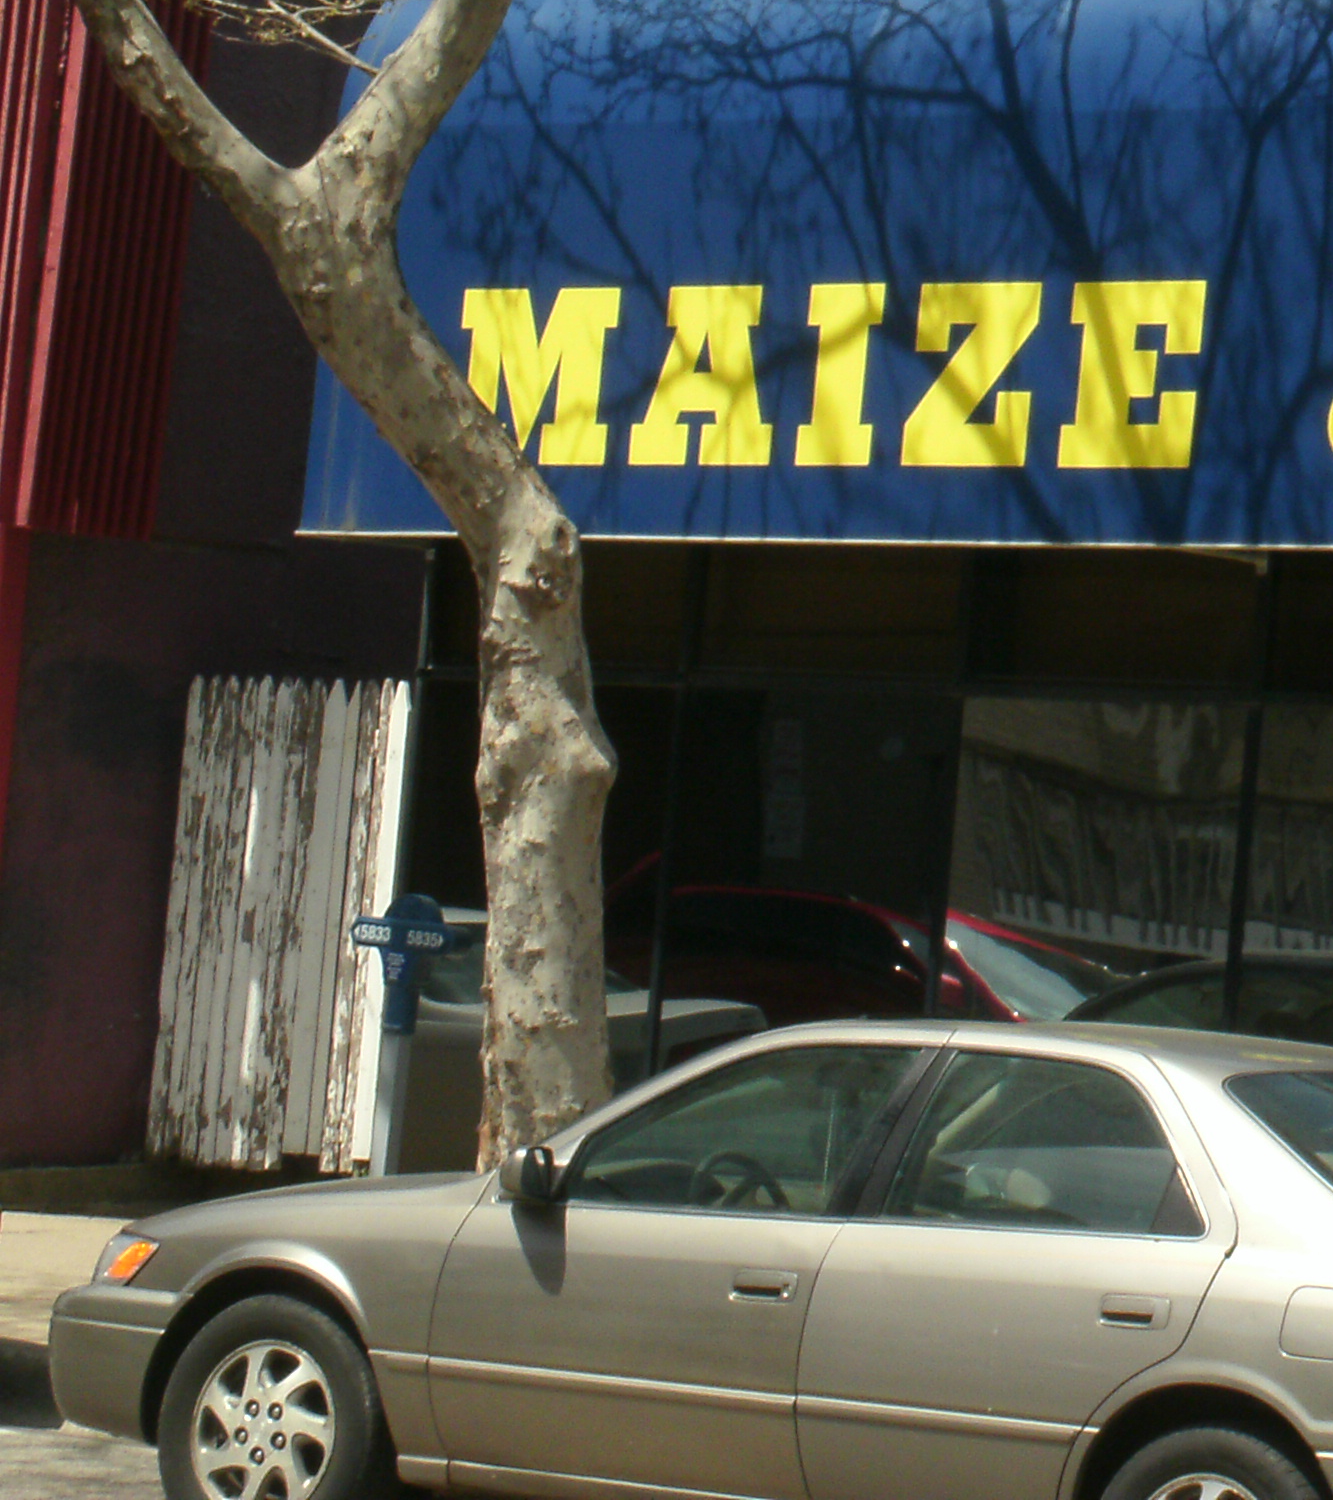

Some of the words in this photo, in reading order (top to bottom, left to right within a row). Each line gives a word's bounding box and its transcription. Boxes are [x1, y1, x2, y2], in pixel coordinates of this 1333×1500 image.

[461, 280, 1207, 469] MAIZE
[360, 925, 391, 941] 5833
[406, 930, 440, 947] 5835
